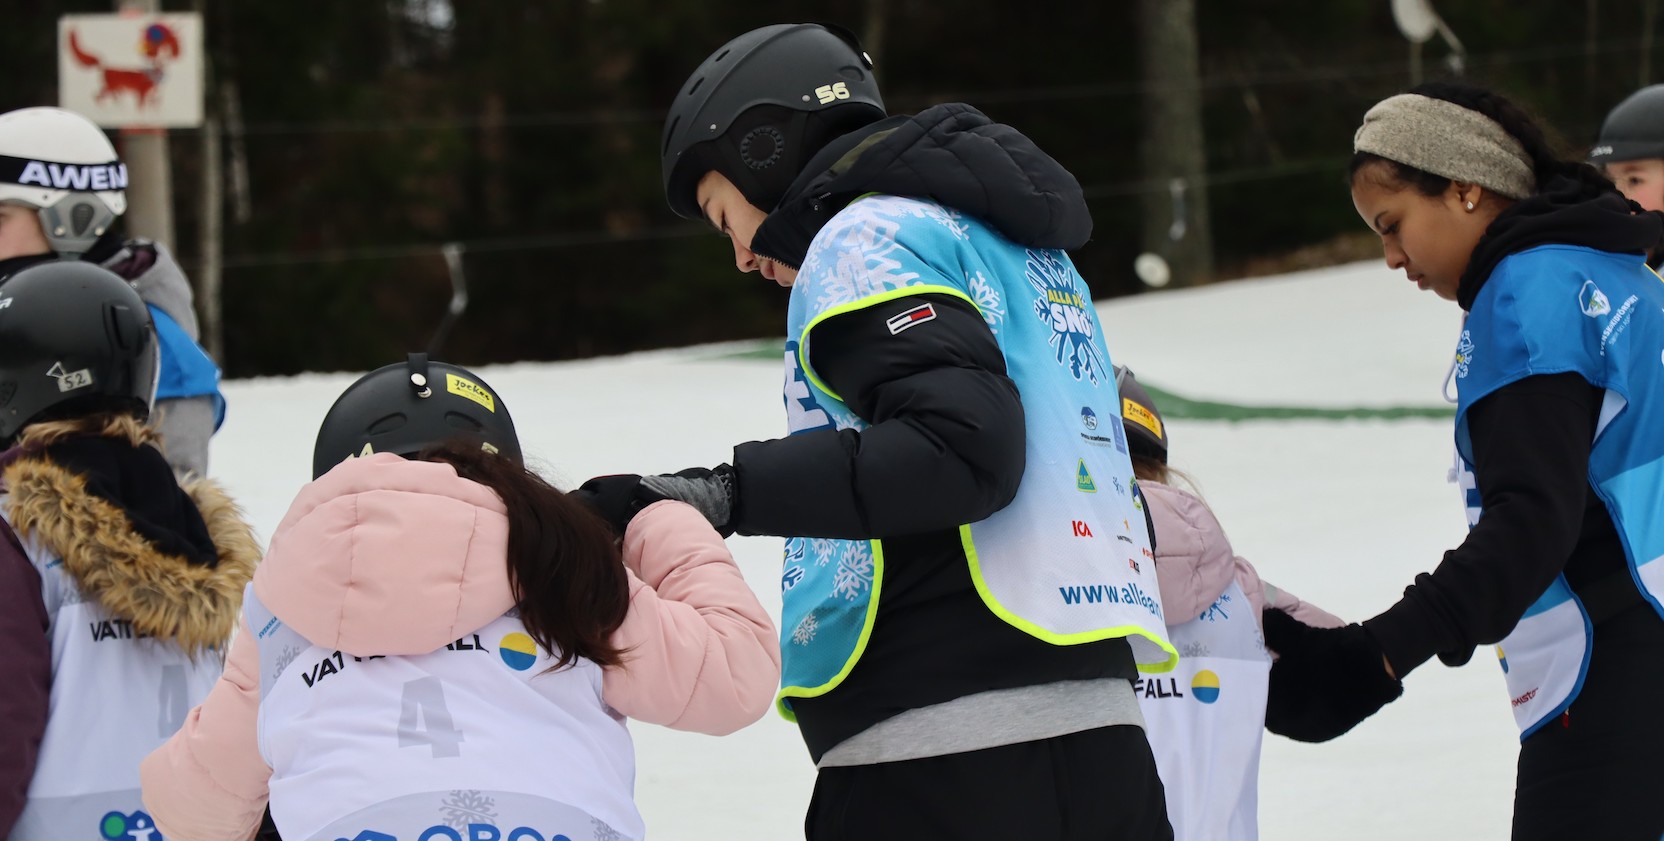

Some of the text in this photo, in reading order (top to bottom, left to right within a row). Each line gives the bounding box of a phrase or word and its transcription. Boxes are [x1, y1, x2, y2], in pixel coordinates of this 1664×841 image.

[815, 82, 850, 104] 56
[19, 161, 128, 190] AWEN
[1047, 289, 1072, 303] ALLA
[64, 373, 86, 390] 52
[1072, 520, 1093, 538] ICA
[398, 675, 466, 760] 4
